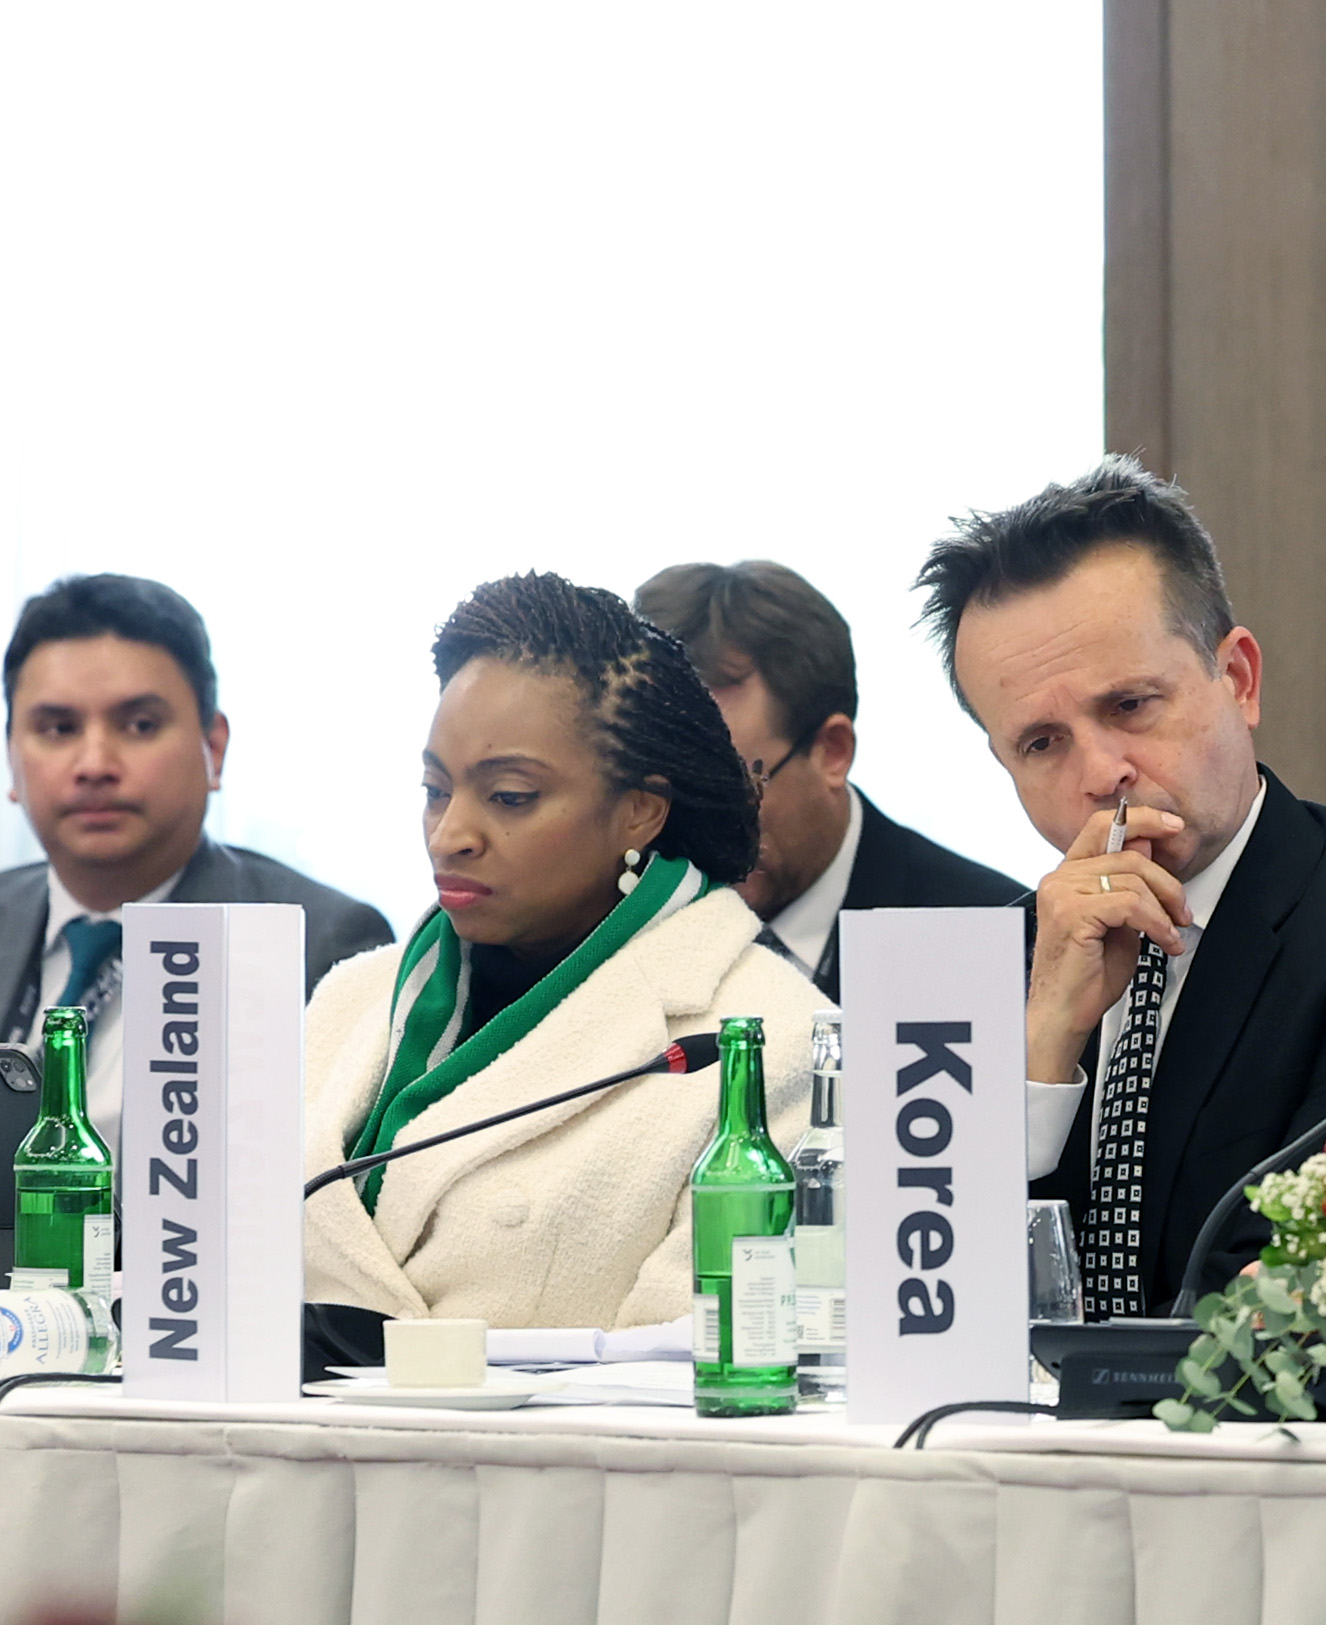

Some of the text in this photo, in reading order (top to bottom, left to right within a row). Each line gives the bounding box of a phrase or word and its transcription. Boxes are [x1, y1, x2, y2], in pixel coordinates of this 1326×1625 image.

[149, 940, 200, 1361] New Zealand
[895, 1021, 974, 1337] Korea
[23, 1296, 50, 1366] ALLEGRA
